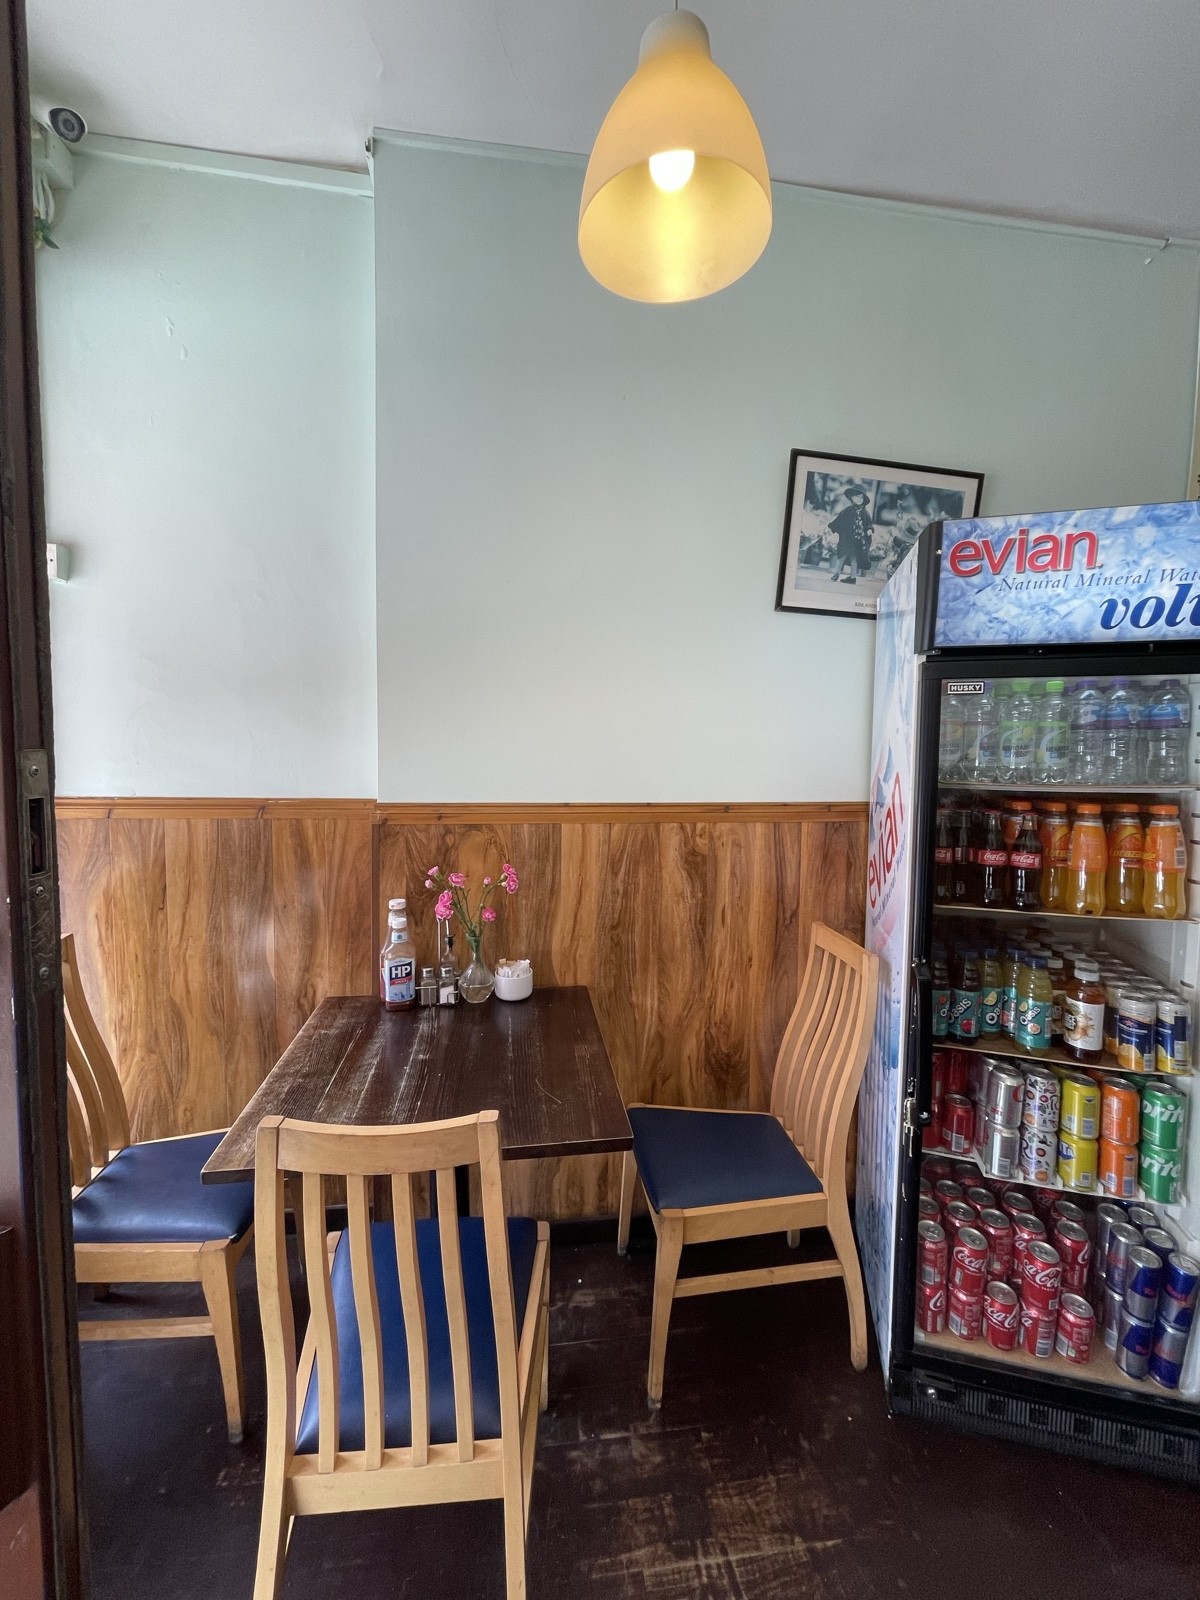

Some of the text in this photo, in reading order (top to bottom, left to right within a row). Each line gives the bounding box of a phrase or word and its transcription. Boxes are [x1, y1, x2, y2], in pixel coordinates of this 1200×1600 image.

[949, 528, 1098, 577] evian
[999, 574, 1068, 592] Natural
[1075, 569, 1149, 587] Mineral
[950, 684, 981, 692] HUSKY
[868, 771, 905, 909] evian
[391, 965, 411, 978] HP
[1020, 1006, 1041, 1025] Oasis
